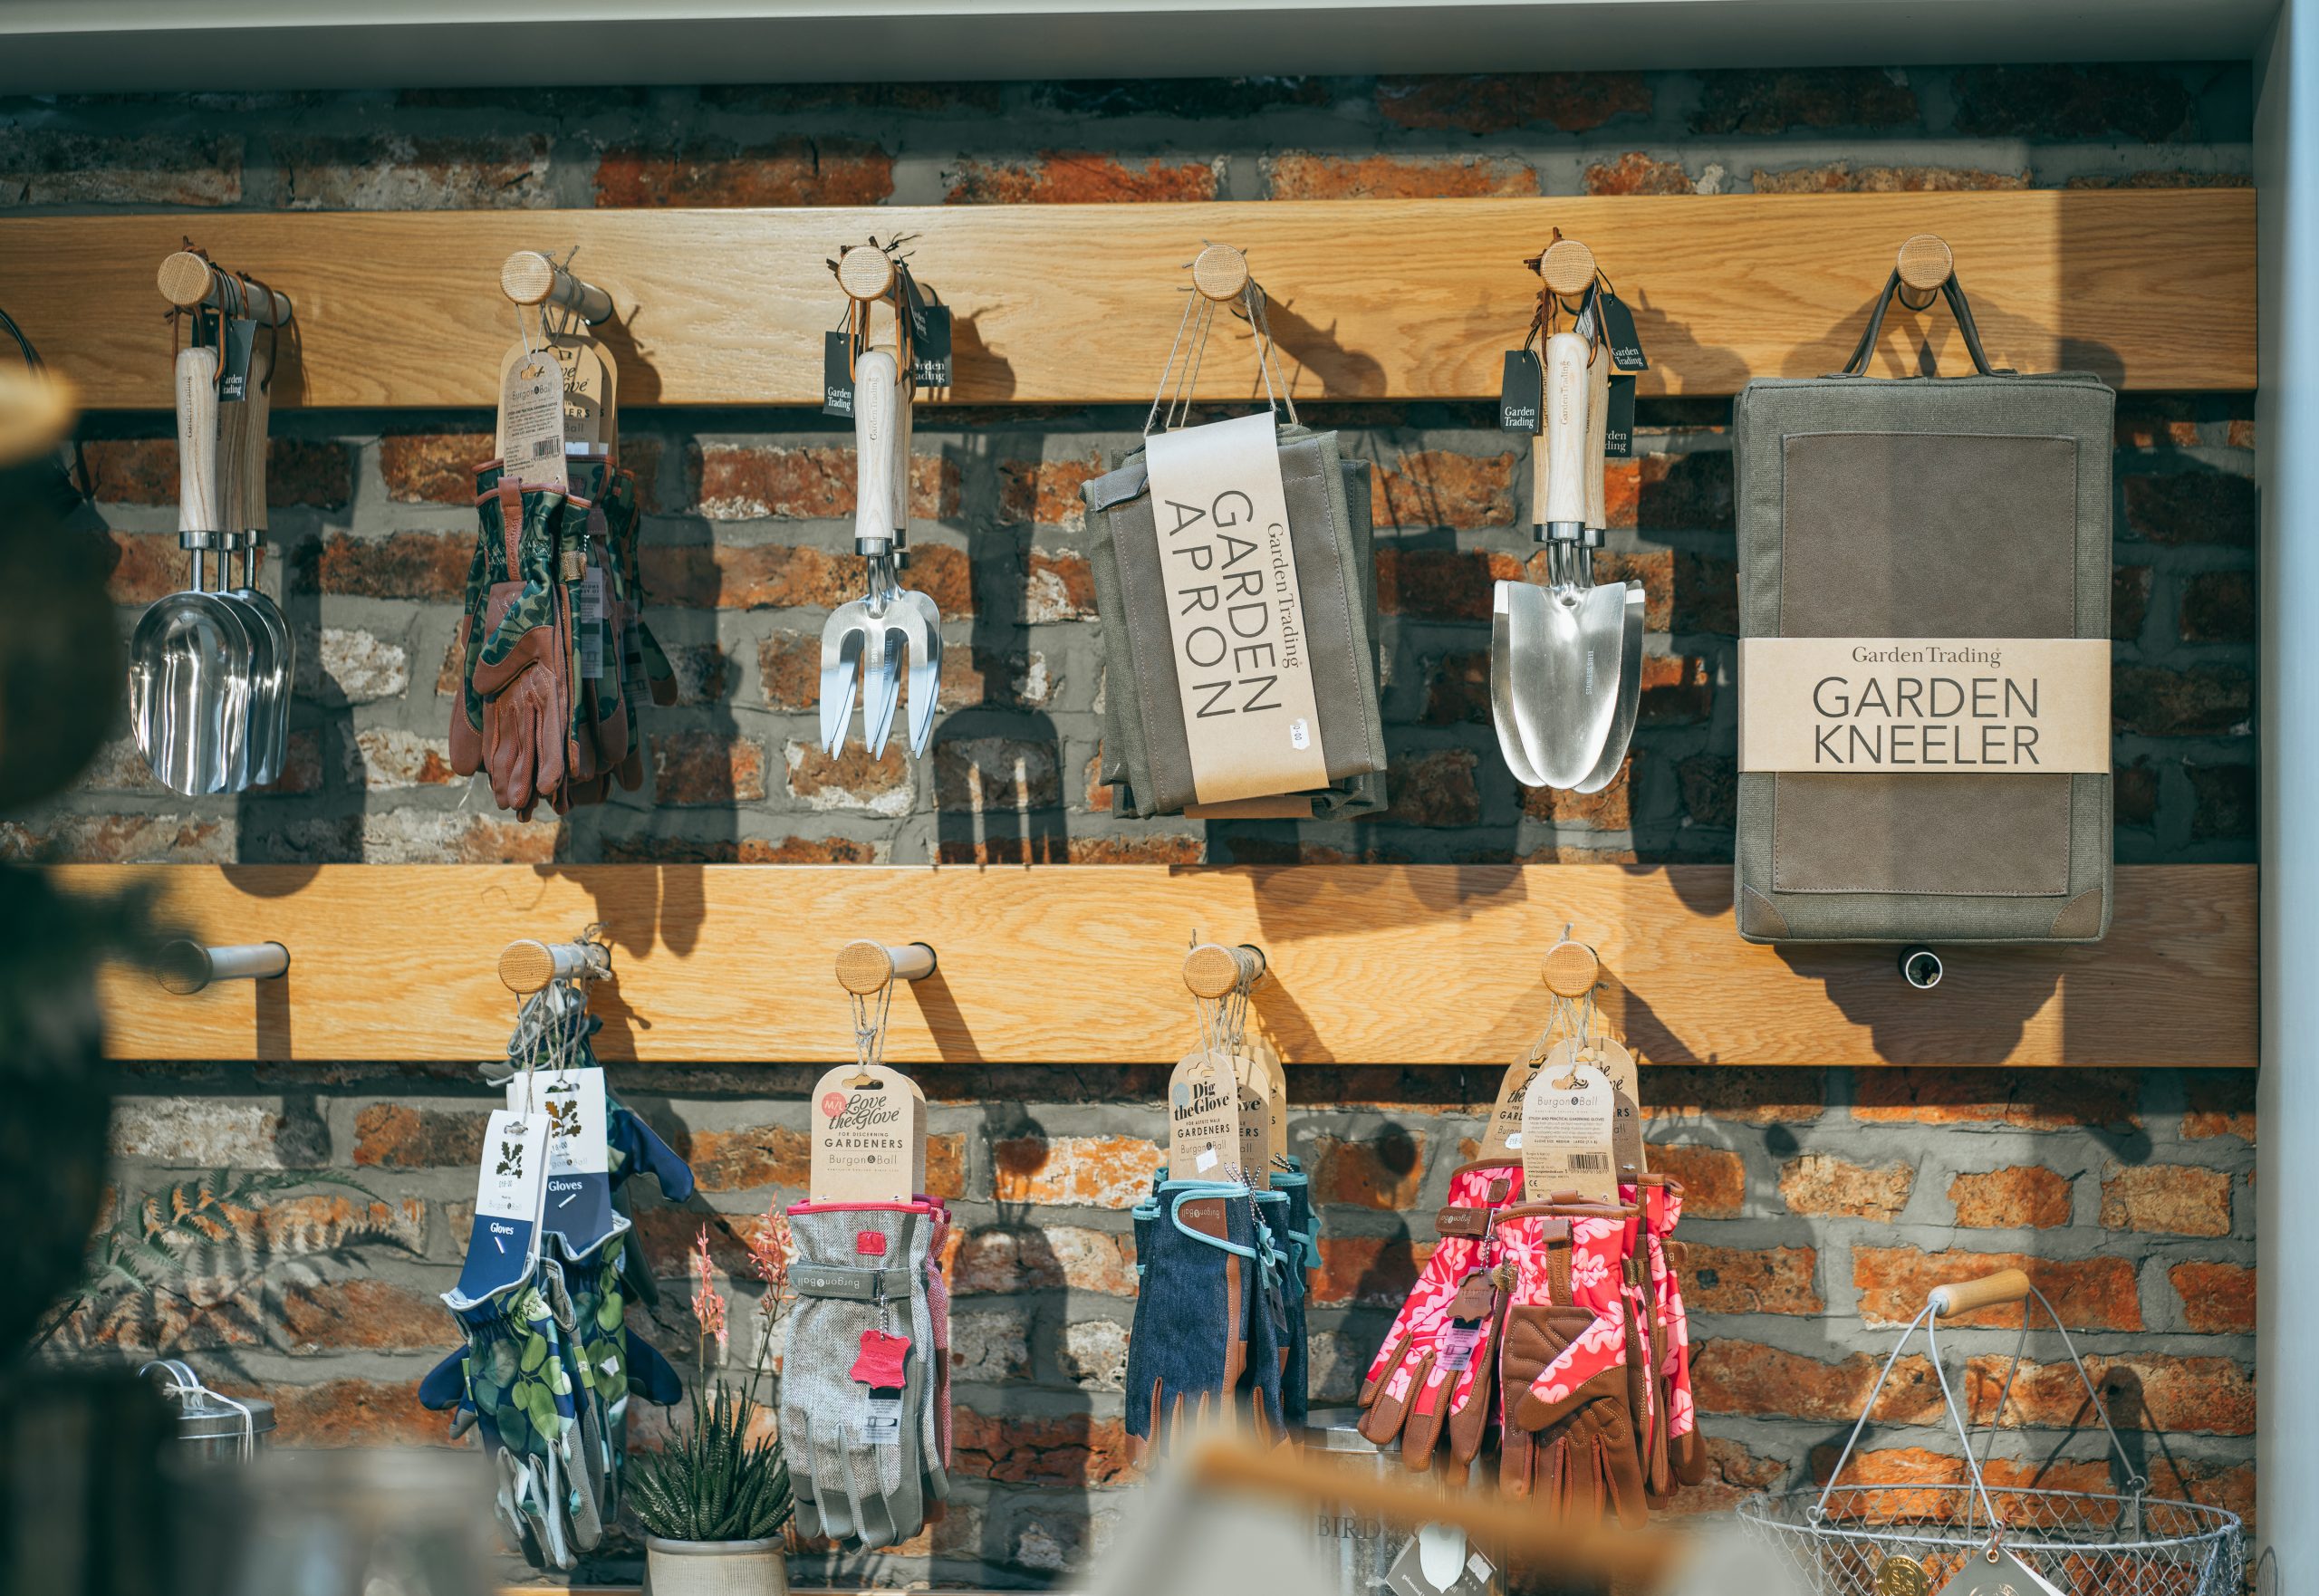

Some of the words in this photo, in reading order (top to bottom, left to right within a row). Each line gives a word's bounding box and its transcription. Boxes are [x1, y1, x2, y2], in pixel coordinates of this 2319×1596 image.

[1611, 347, 1639, 357] Garden
[1614, 356, 1643, 367] Trading
[827, 387, 852, 399] Garden
[827, 397, 852, 411] Trading
[1505, 406, 1535, 417] Garden
[870, 409, 878, 441] Garden
[1504, 417, 1535, 428] Trading
[1211, 490, 1282, 714] GARDEN
[1267, 522, 1288, 591] Garden
[1278, 593, 1300, 668] Trading
[1165, 499, 1236, 718] APRON
[1852, 646, 1923, 664] Garden
[1926, 646, 2002, 668] Trading
[1813, 677, 2038, 718] GARDEN
[1814, 724, 2040, 764] KNEELER
[1193, 1081, 1216, 1099] Dig
[824, 1100, 843, 1110] M/L
[845, 1093, 887, 1115] Love
[1537, 1096, 1598, 1109] Burgon&Ball
[1178, 1123, 1230, 1138] GARDENERS
[824, 1139, 903, 1149] GARDENERS
[548, 1180, 582, 1192] Gloves
[1528, 1179, 1538, 1187] CE
[490, 1222, 515, 1235] Gloves
[797, 1276, 860, 1290] Burgon&Ball
[1317, 1514, 1381, 1540] BIRD
